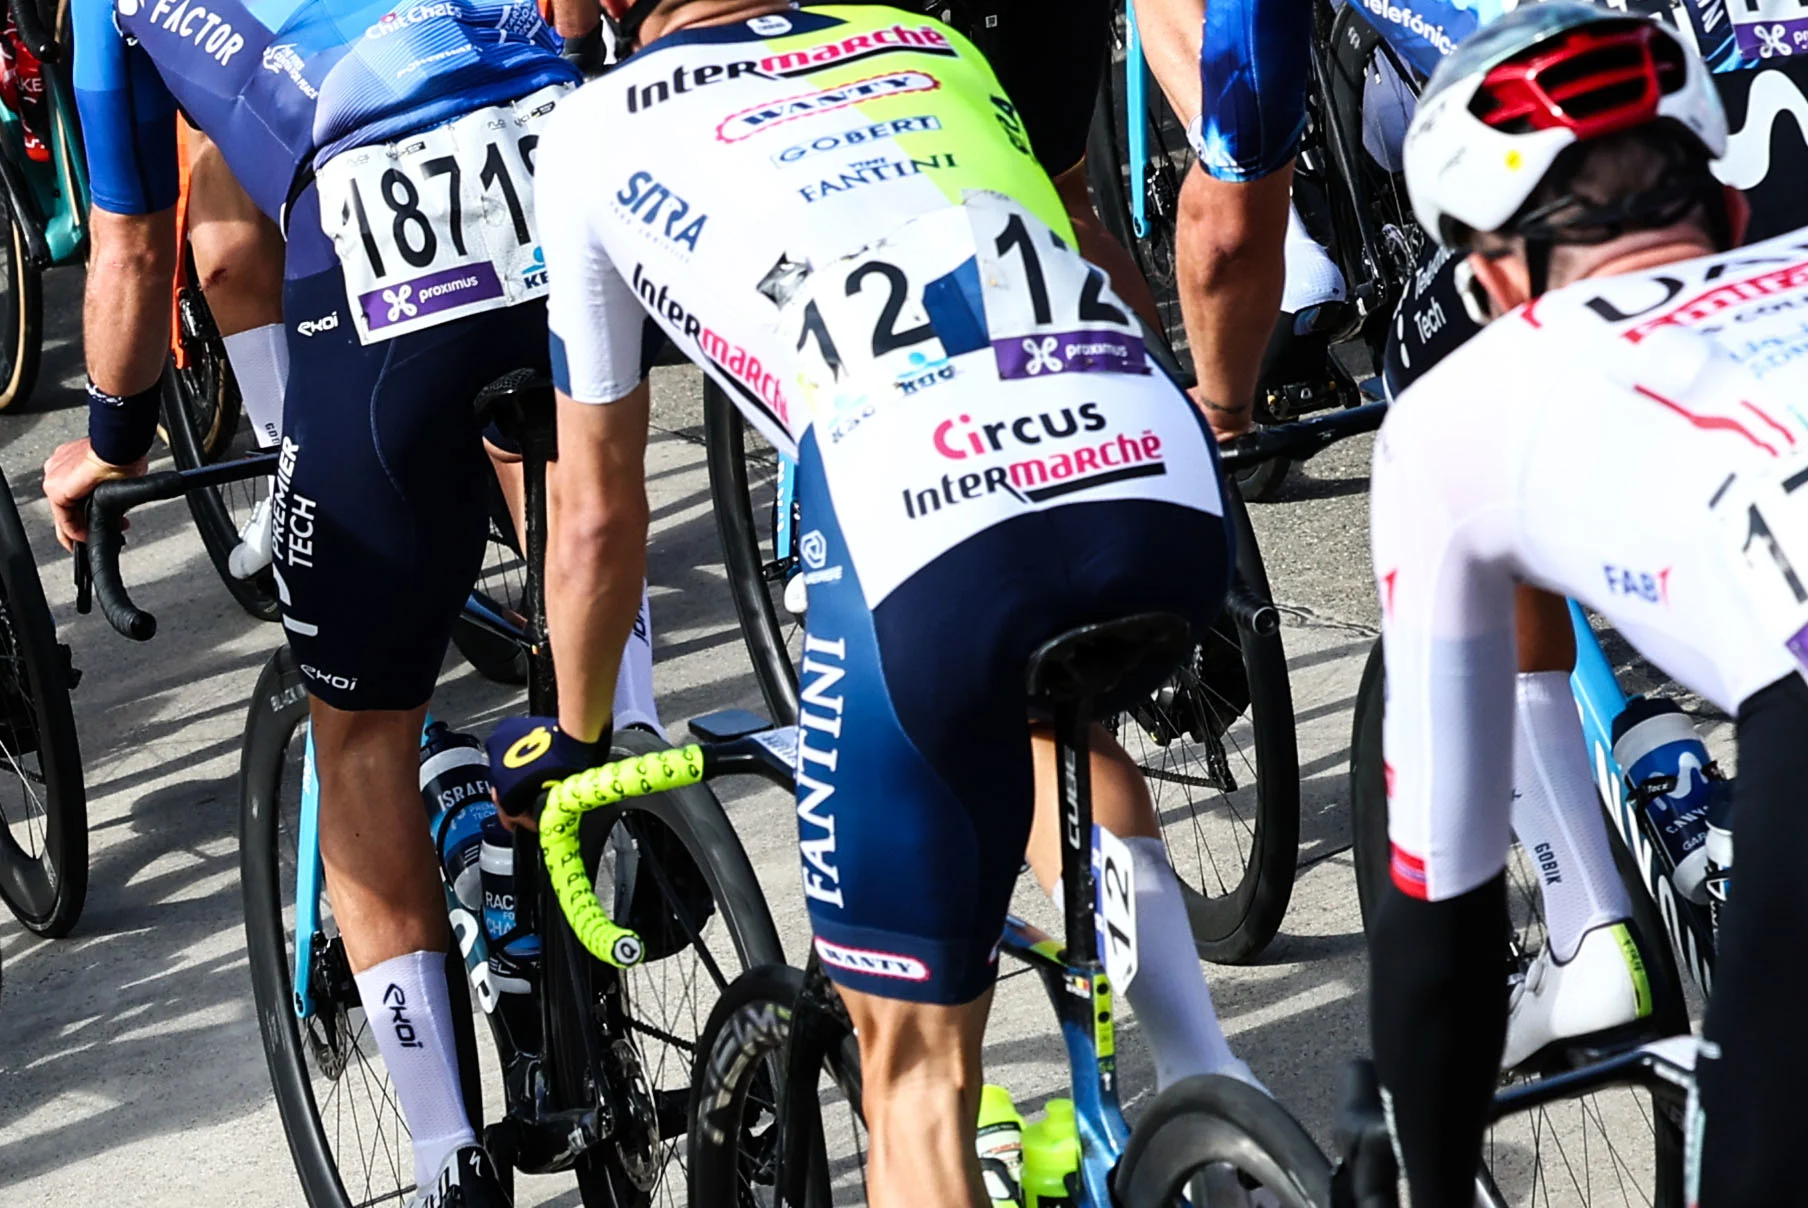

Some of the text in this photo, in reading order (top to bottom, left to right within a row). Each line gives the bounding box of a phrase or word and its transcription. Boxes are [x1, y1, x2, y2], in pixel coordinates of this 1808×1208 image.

[626, 25, 950, 116] Intermarché
[741, 75, 913, 126] WANTY
[780, 116, 936, 163] GOBERT
[798, 152, 958, 203] FANTINI
[342, 156, 468, 278] 187
[616, 170, 710, 254] SITRA
[417, 274, 479, 303] proximus
[797, 260, 937, 381] 12
[1064, 339, 1130, 362] proximus
[1412, 300, 1446, 347] Tech
[931, 401, 1109, 462] Circus
[271, 435, 300, 560] PREMIER
[287, 494, 316, 568] TECH
[797, 635, 846, 912] FANTINI
[1066, 747, 1084, 852] CUBE
[1536, 842, 1561, 886] GOBIK
[1103, 857, 1134, 959] 12
[822, 944, 918, 979] WANTY
